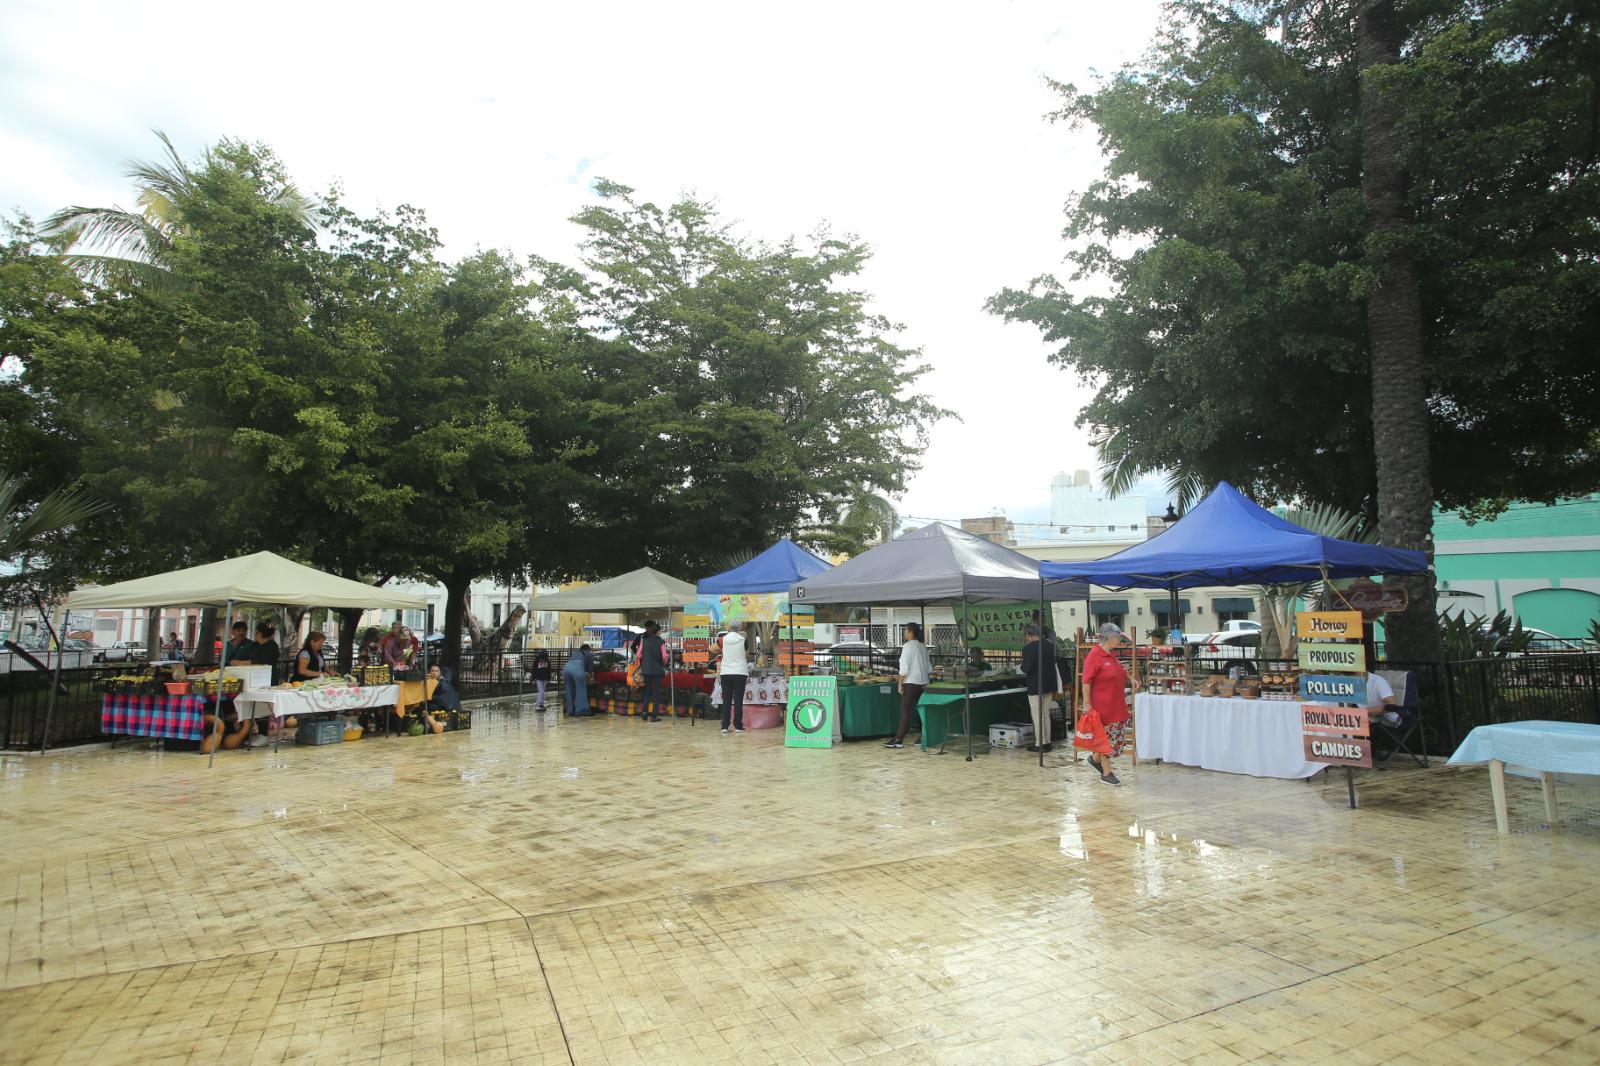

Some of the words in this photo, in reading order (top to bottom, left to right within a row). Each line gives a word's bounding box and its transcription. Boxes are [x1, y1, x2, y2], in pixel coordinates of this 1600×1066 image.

[973, 612, 1000, 621] VIDA
[1006, 609, 1046, 620] VERE
[977, 623, 1025, 633] VEGETA
[1310, 618, 1348, 634] Honey
[1309, 651, 1355, 665] PROPOLIS
[793, 680, 808, 688] VIDA
[810, 680, 831, 688] VERDE
[1307, 681, 1354, 696] POLLEN
[793, 689, 830, 697] VEGETALES
[807, 708, 823, 728] V
[1304, 711, 1331, 726] ROYAL
[1333, 712, 1362, 728] JELLY
[1311, 741, 1363, 760] CANDIES
